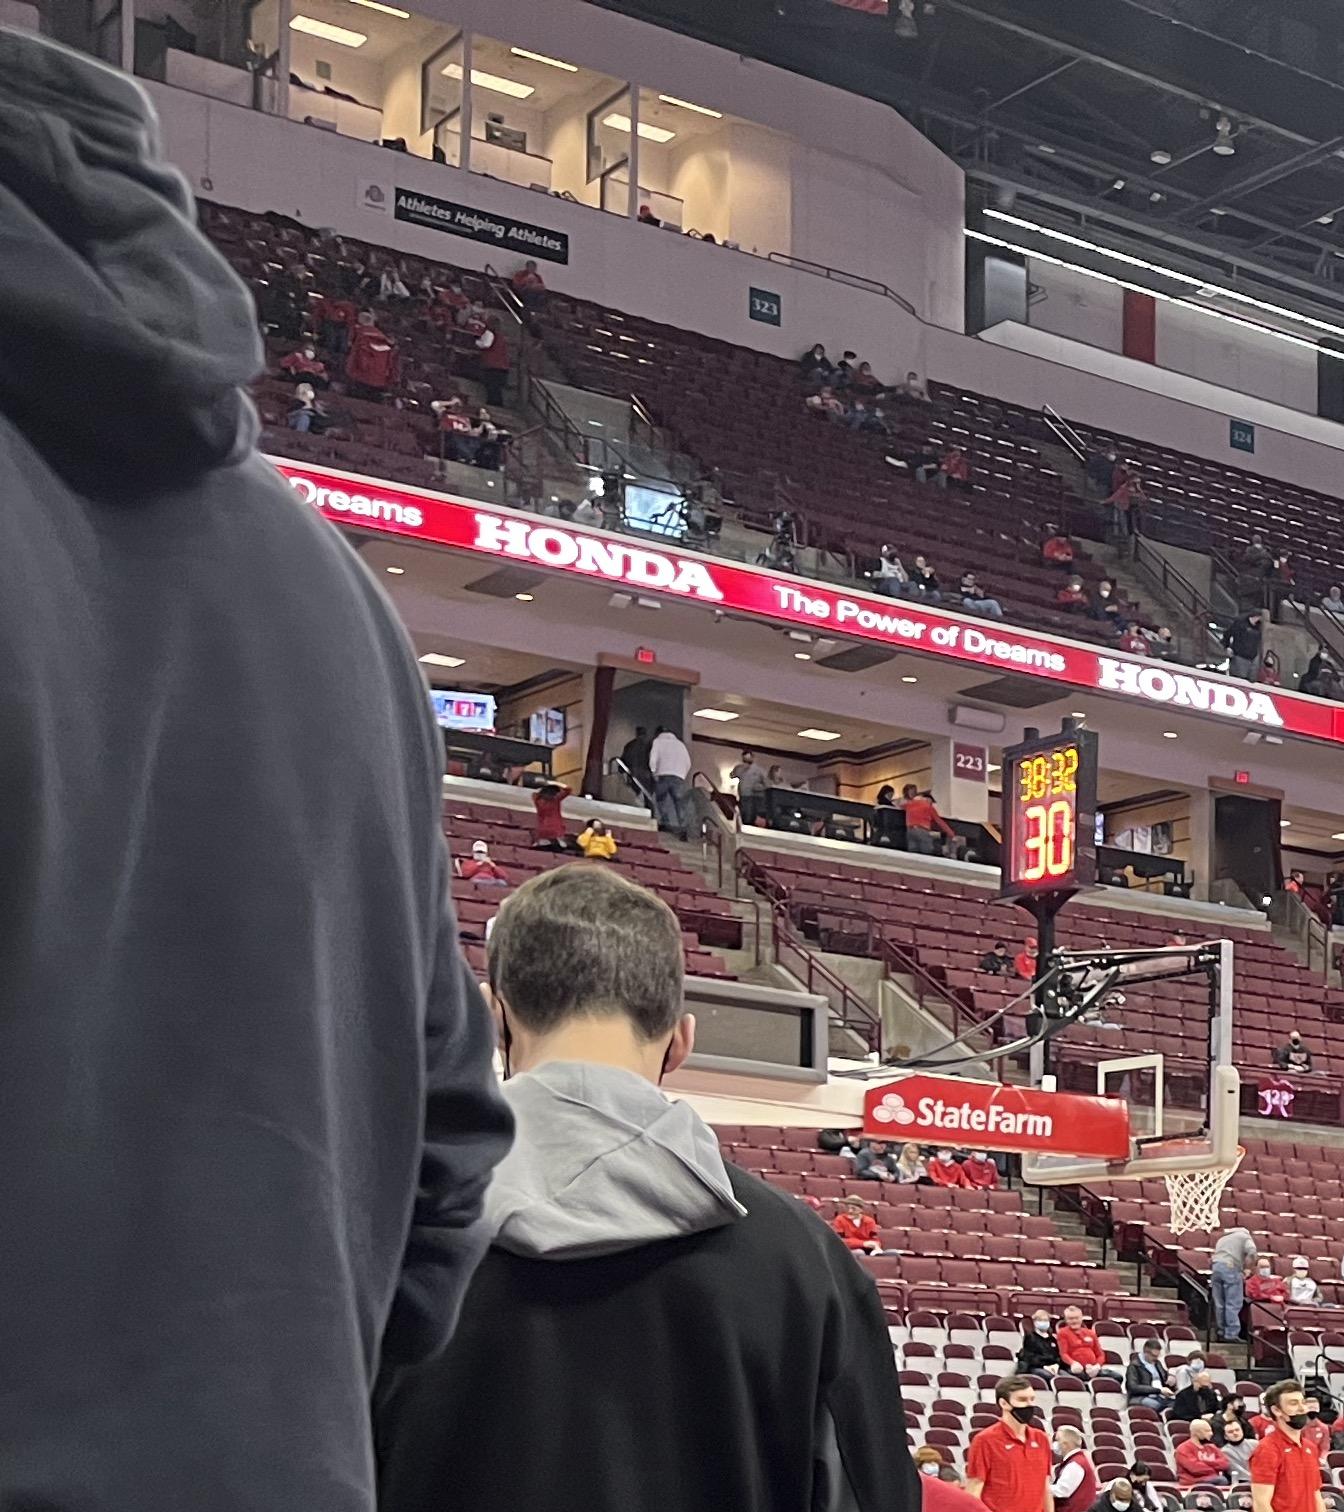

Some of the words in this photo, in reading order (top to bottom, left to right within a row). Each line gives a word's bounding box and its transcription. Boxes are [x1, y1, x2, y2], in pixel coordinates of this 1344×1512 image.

[397, 195, 451, 220] Athletes
[454, 211, 505, 238] Helping
[507, 226, 562, 251] Athletes
[755, 297, 779, 316] 323
[289, 476, 423, 527] Dreams
[474, 513, 725, 601] HONDA
[772, 584, 831, 619] The
[836, 599, 927, 640] Power
[930, 624, 961, 646] of
[963, 628, 1066, 673] Dreams
[1097, 657, 1285, 727] HONDA
[956, 753, 985, 771] 223
[1020, 748, 1079, 802] 38:32
[1024, 801, 1072, 881] 30
